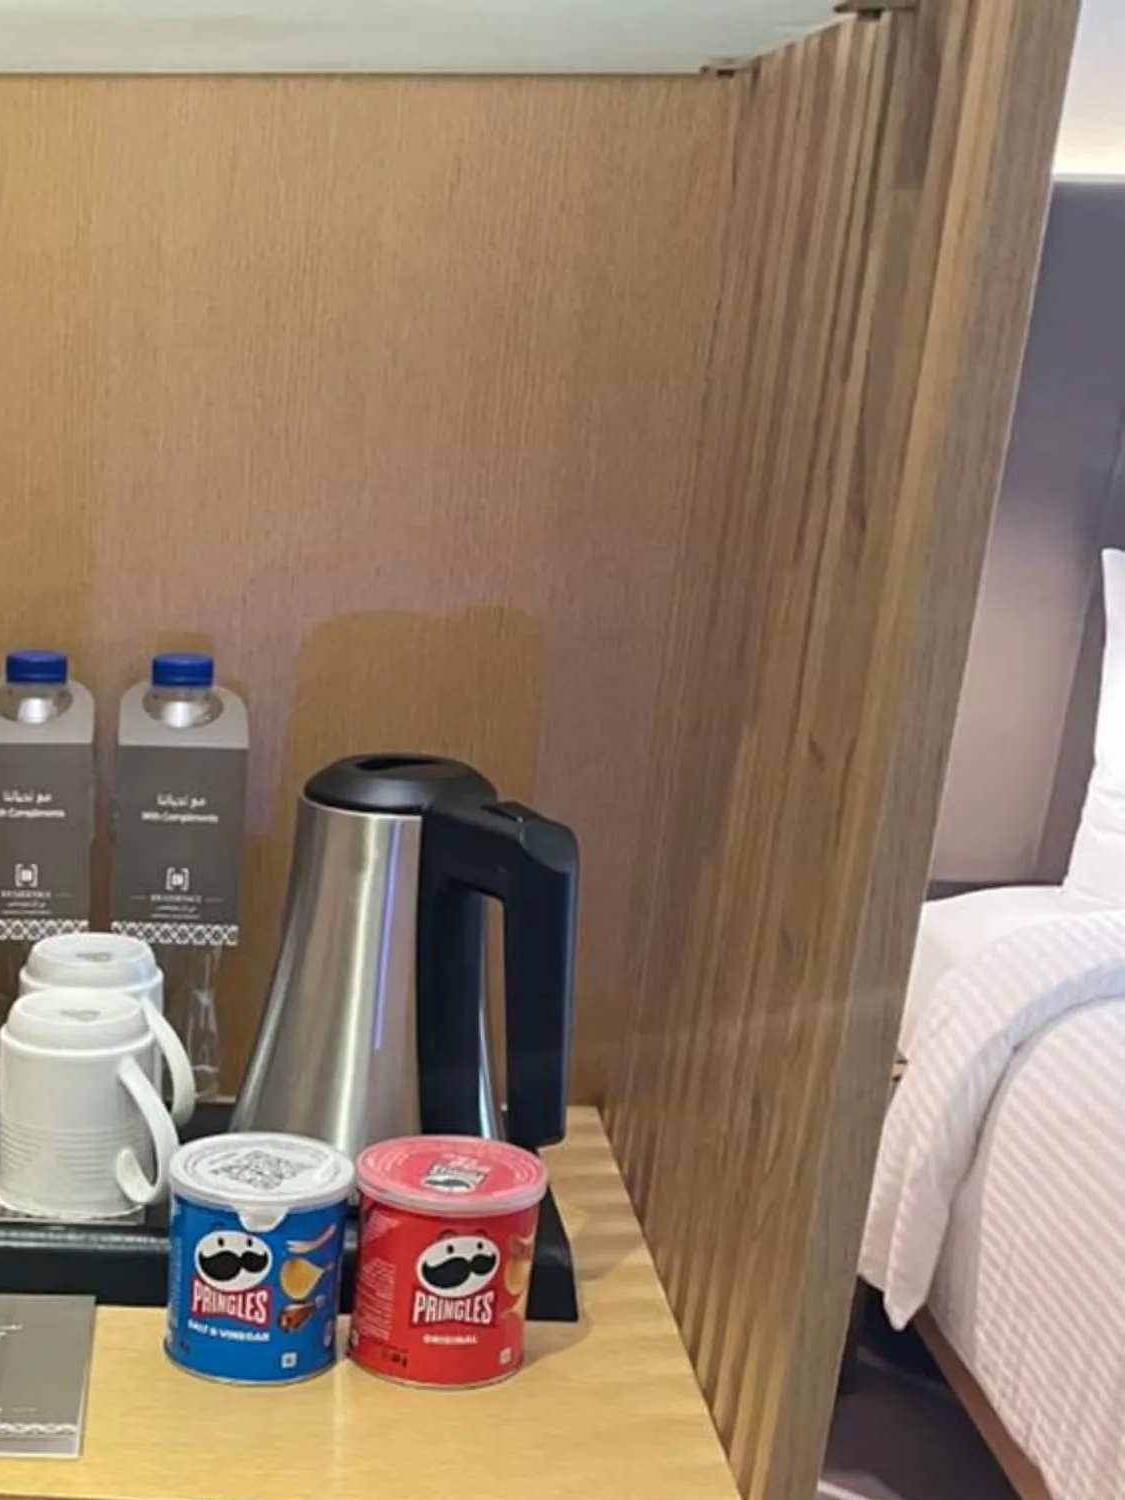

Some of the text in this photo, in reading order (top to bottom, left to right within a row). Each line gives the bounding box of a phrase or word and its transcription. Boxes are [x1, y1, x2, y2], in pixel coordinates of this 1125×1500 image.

[190, 1279, 269, 1325] PRINGLES
[412, 1290, 496, 1325] PRINGLES
[187, 1318, 208, 1334] SALT
[218, 1328, 271, 1343] VINEGAR
[422, 1333, 479, 1345] ORIGINAL
